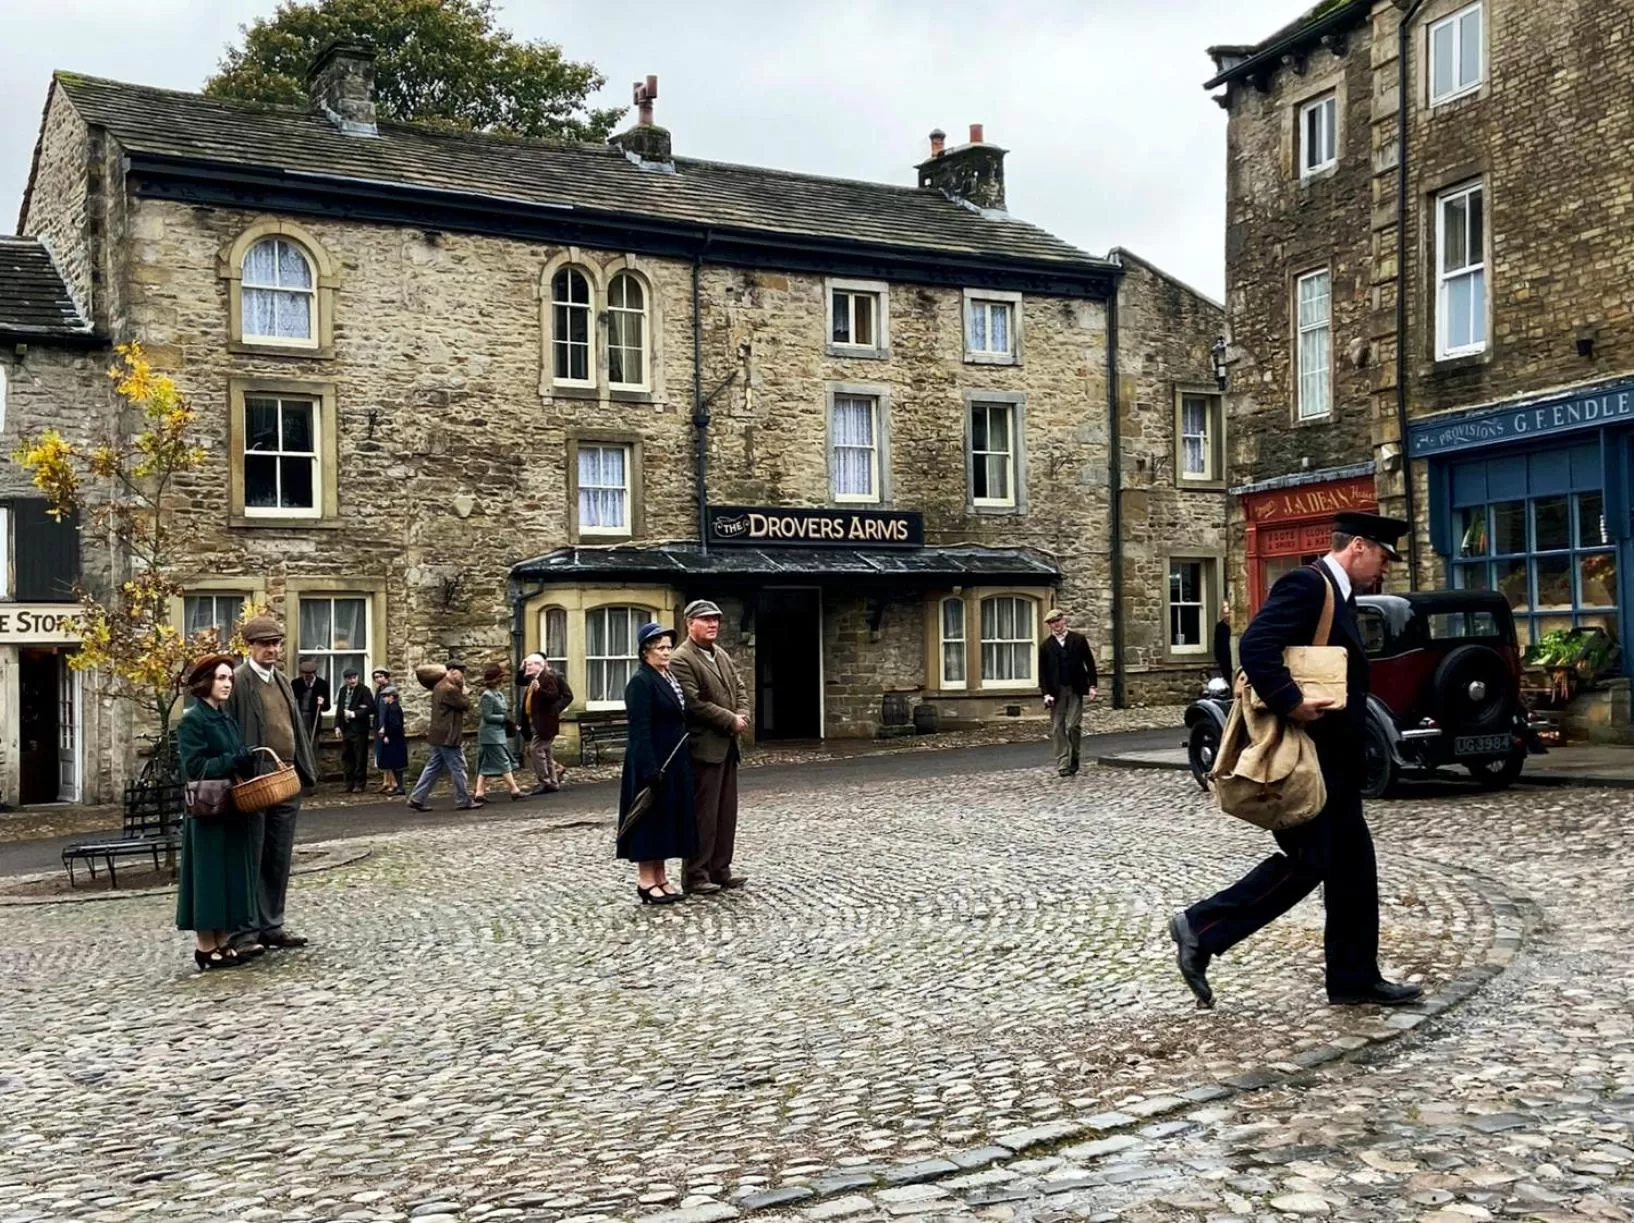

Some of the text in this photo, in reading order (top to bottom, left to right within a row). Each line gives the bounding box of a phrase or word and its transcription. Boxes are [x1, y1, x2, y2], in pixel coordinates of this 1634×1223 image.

[1439, 423, 1505, 446] PROVISIONS
[723, 513, 909, 540] THE DROVERS ARMS
